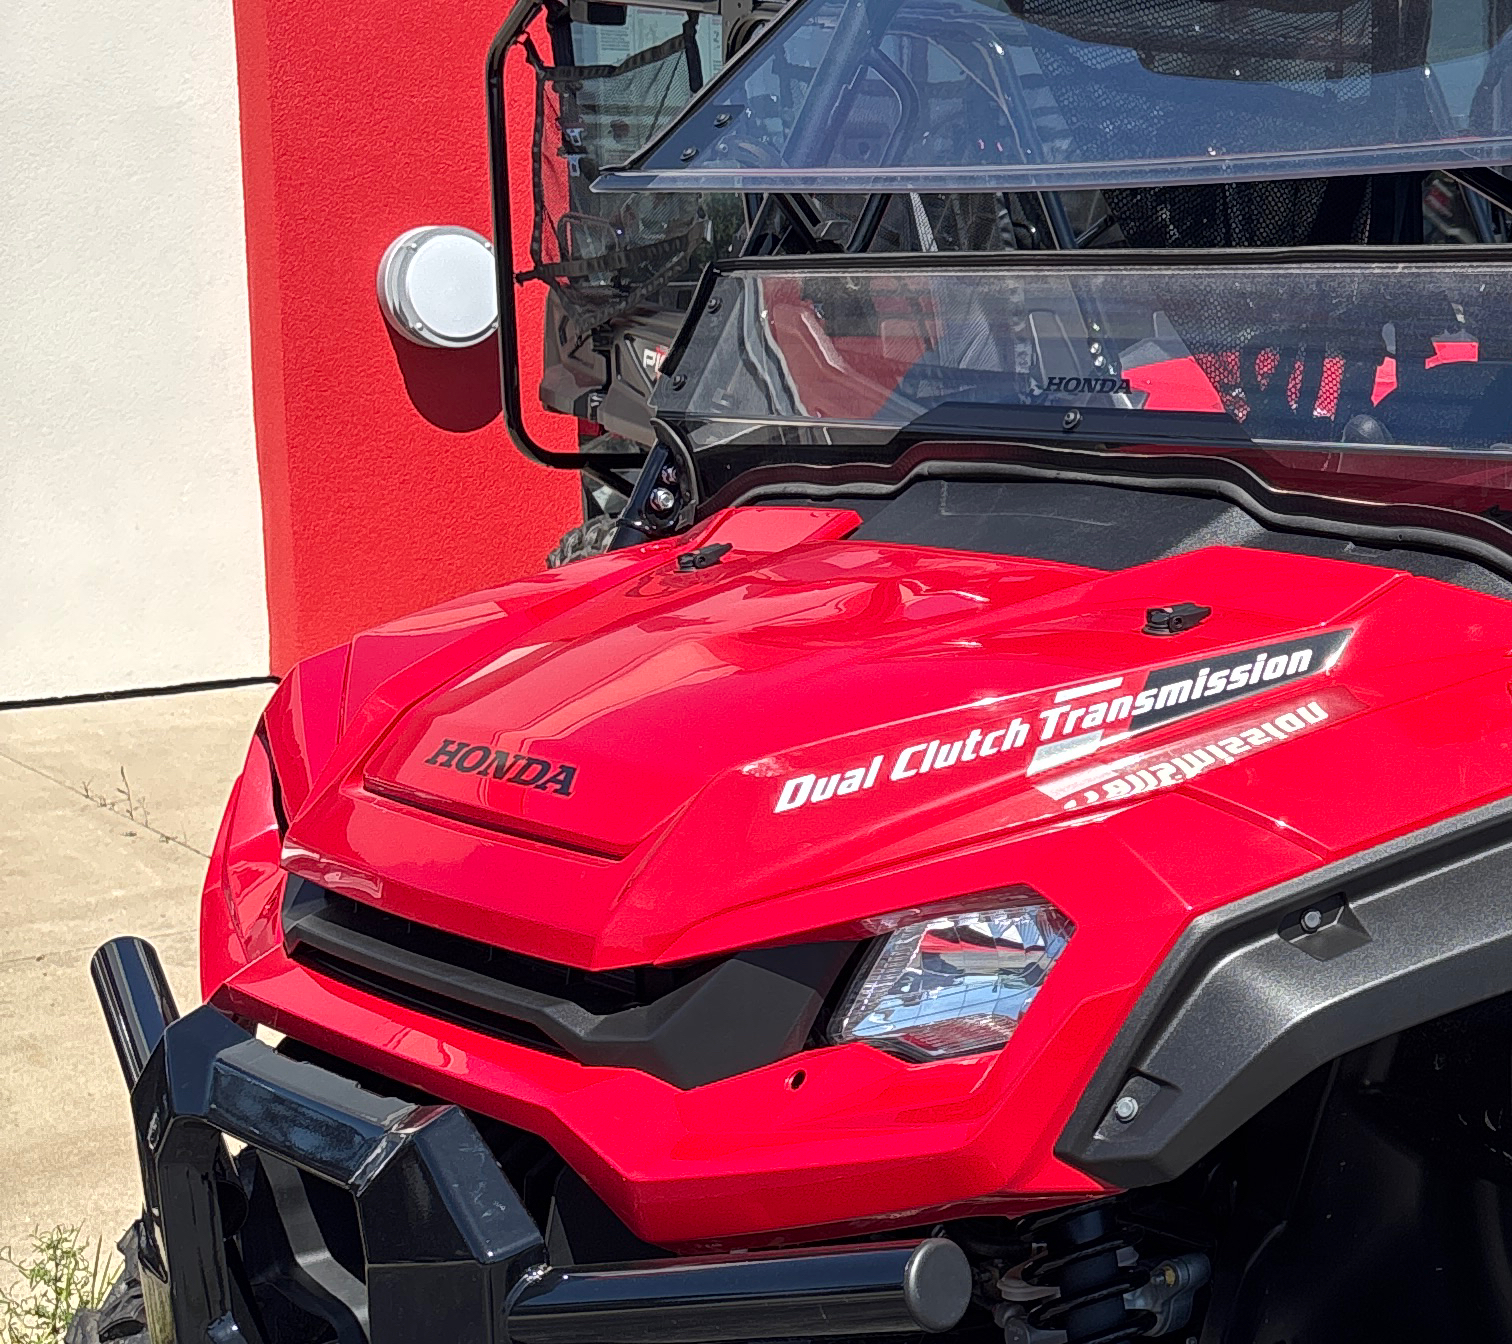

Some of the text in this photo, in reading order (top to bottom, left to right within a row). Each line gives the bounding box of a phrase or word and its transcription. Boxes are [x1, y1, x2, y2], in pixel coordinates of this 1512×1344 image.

[1043, 376, 1133, 395] HONDA
[773, 647, 1313, 814] Dual Clutch Transmission
[424, 738, 577, 797] HONDA
